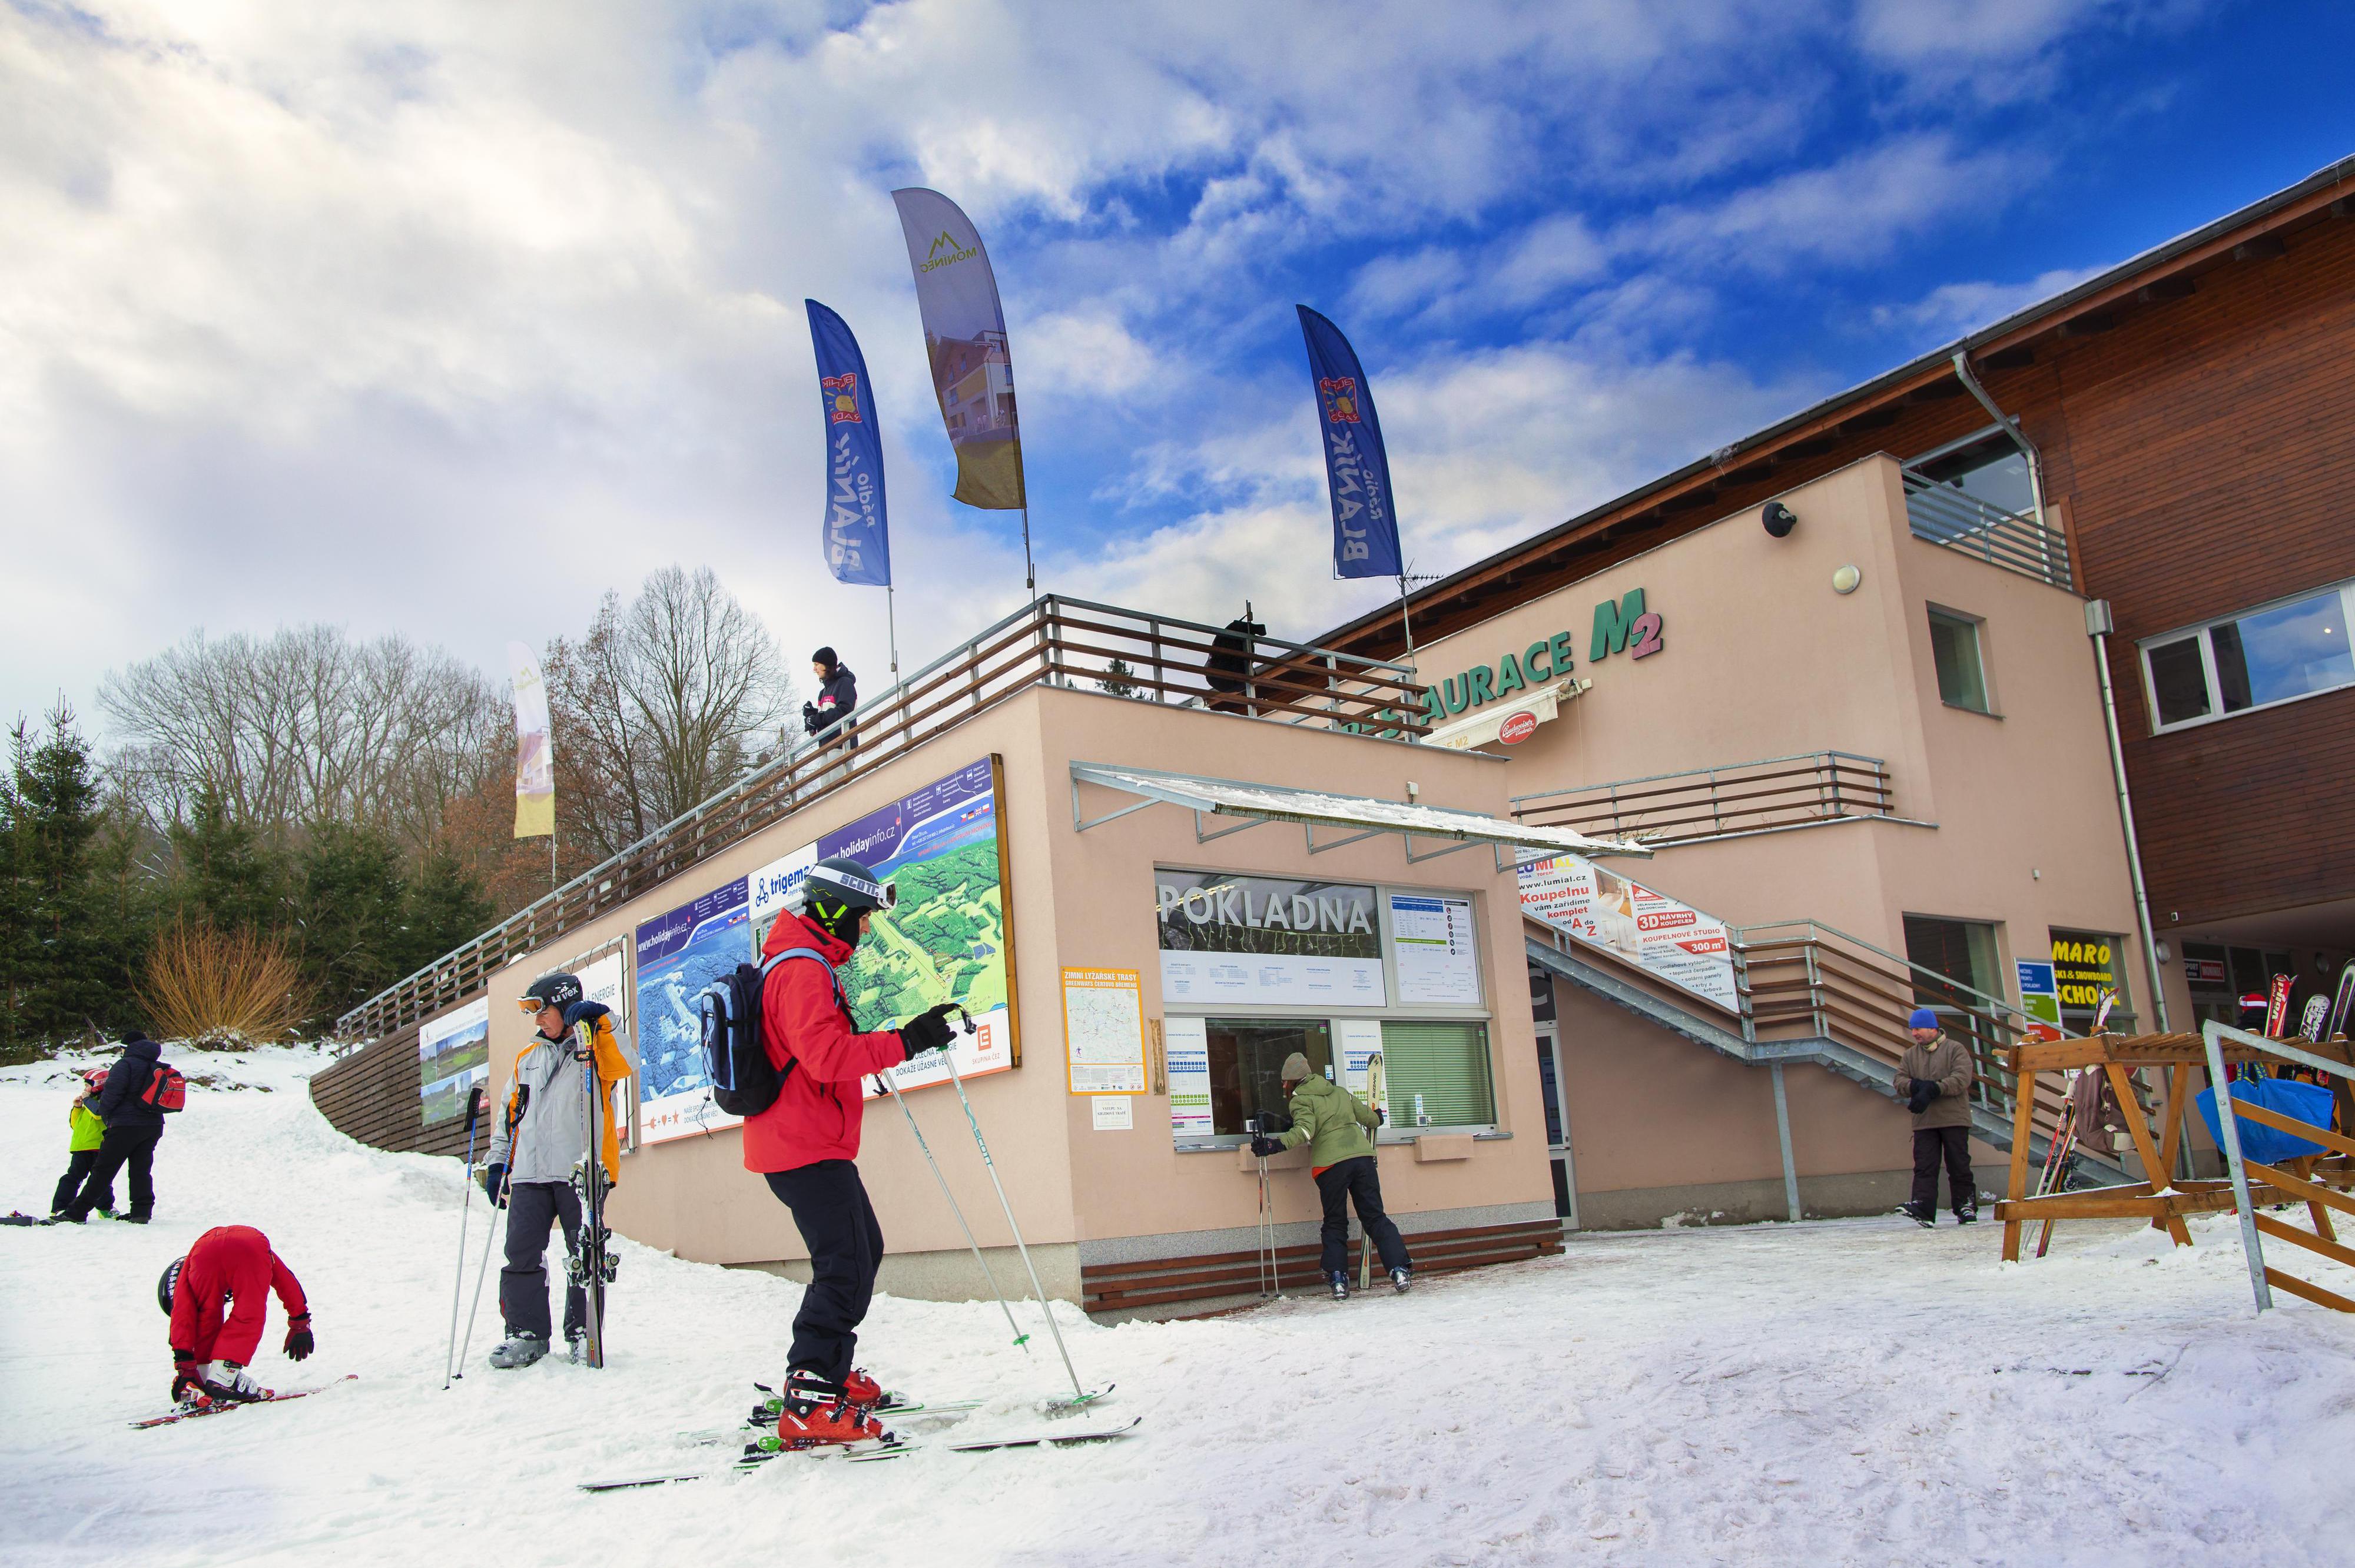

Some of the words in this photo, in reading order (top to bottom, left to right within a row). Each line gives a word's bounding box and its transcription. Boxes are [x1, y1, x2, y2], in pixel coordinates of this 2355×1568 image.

[1589, 587, 1664, 663] M2
[1502, 719, 1534, 738] Budweiser
[1455, 735, 1469, 749] M2
[1517, 857, 1575, 875] LUMIAL
[771, 865, 810, 895] trigema
[840, 873, 880, 895] SCOTT
[1518, 875, 1587, 891] www.lumial.cz
[1520, 886, 1590, 905] Koupelnu
[1554, 898, 1590, 909] zařídíme
[1157, 884, 1373, 935] POKLADNA
[1547, 906, 1588, 919] komplet
[1572, 918, 1583, 929] A
[1638, 915, 1659, 929] 3D
[1659, 912, 1693, 921] NÁVRHY
[1660, 918, 1694, 926] KOUPELEN
[637, 922, 687, 953] www.holidayinfo.cz
[1587, 925, 1597, 936] Z
[1643, 931, 1691, 943] KOUPELNOVÉ
[1693, 928, 1720, 936] STUDIO
[1691, 942, 1710, 952] 300
[2051, 940, 2111, 965] MARO
[1659, 962, 1687, 970] podlahové
[1687, 959, 1710, 967] vytápění
[1693, 965, 1716, 974] čerpadla
[1064, 971, 1084, 979] ZIMNÍ
[1084, 971, 1116, 981] LYŽAŘSKÉ
[1116, 973, 1137, 981] TRASY
[2054, 970, 2067, 979] SKI
[2067, 970, 2075, 979] &
[2076, 971, 2112, 982] SNOWBOARD
[550, 985, 579, 1003] uvex
[591, 984, 615, 1002] ENERGIE
[895, 1064, 916, 1077] DOKÁŽE
[916, 1058, 938, 1071] ÚŽASNÉ
[938, 1055, 948, 1066] VĚC
[971, 1055, 991, 1065] SKUPINA
[973, 1128, 994, 1167] SCOTT
